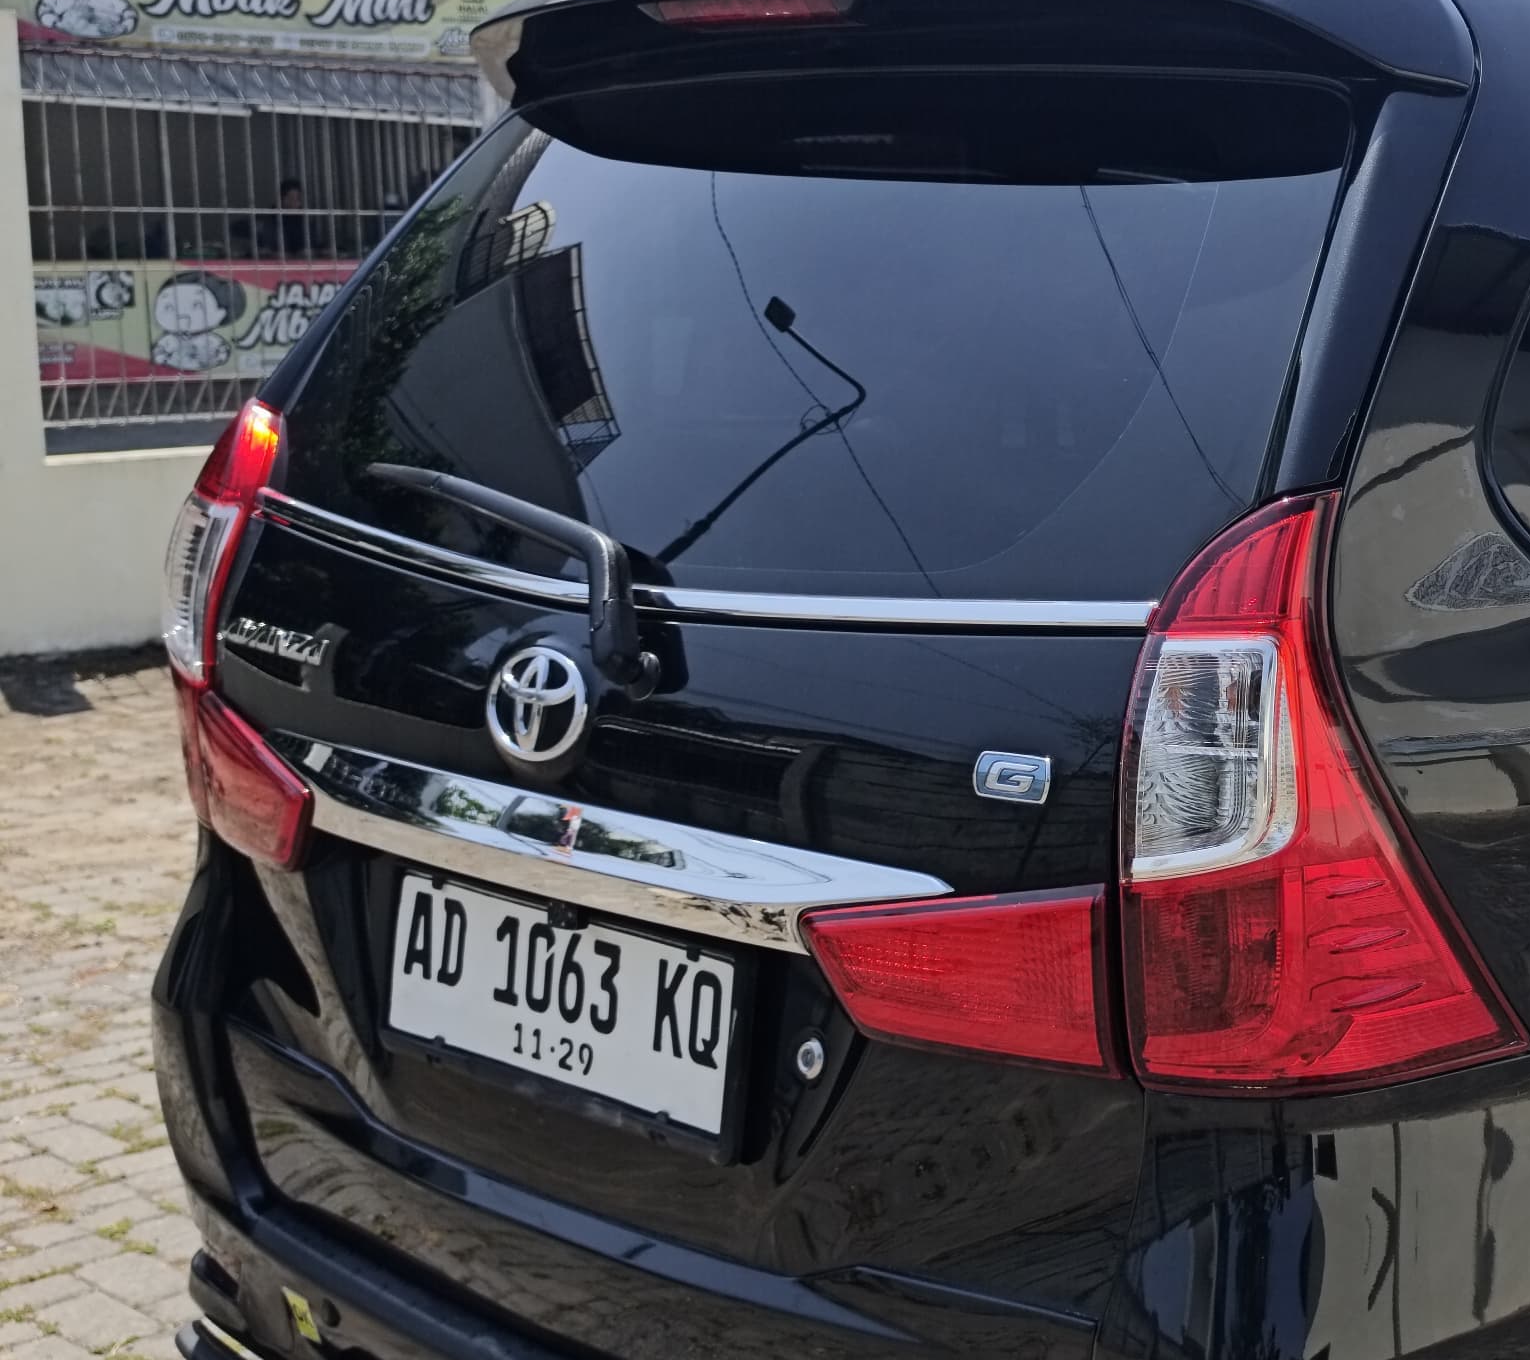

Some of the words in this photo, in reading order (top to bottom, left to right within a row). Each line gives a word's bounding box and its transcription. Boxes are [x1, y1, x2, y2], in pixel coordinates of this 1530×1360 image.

[269, 282, 343, 308] JAJA
[234, 308, 312, 349] Mb
[985, 760, 1040, 793] G
[403, 891, 467, 987] AD
[493, 915, 621, 1035] 1063
[652, 958, 723, 1070] KQ
